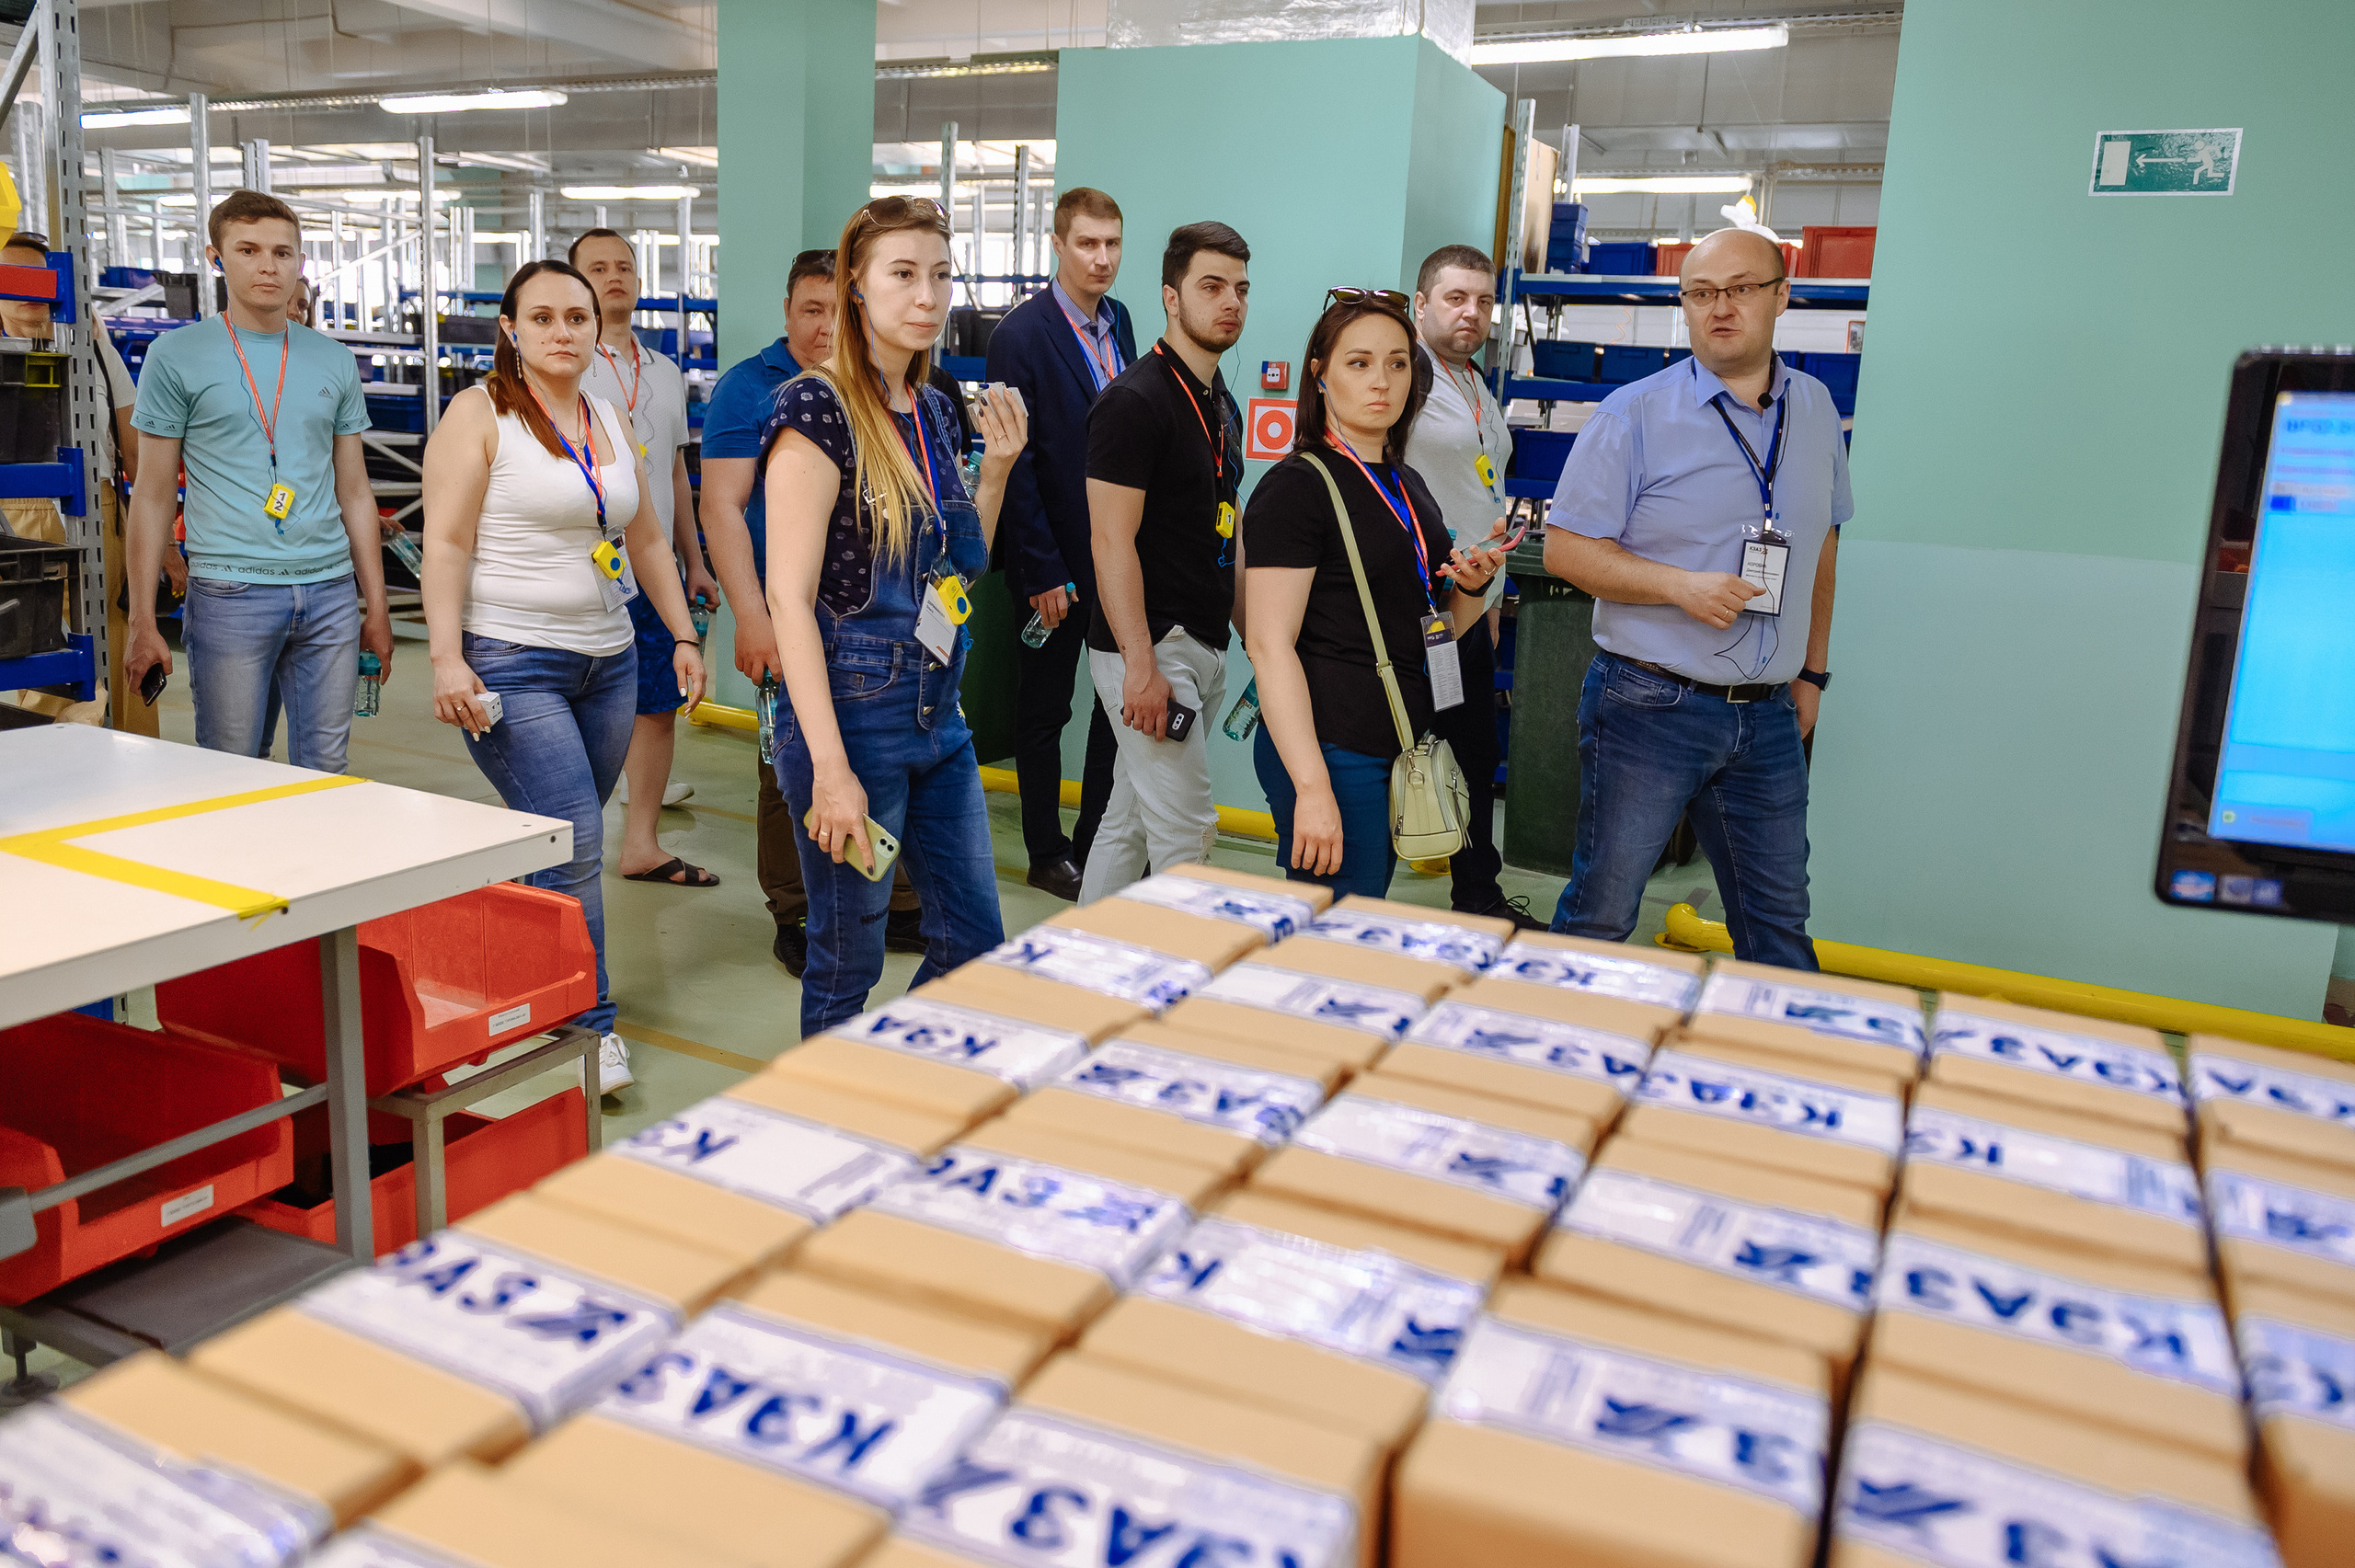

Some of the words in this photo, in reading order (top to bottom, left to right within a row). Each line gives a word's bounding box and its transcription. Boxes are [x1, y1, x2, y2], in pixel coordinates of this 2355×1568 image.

[237, 566, 275, 576] adidas
[1904, 1266, 2187, 1364] КЭАЗ
[615, 1349, 898, 1471] КЭАЗ
